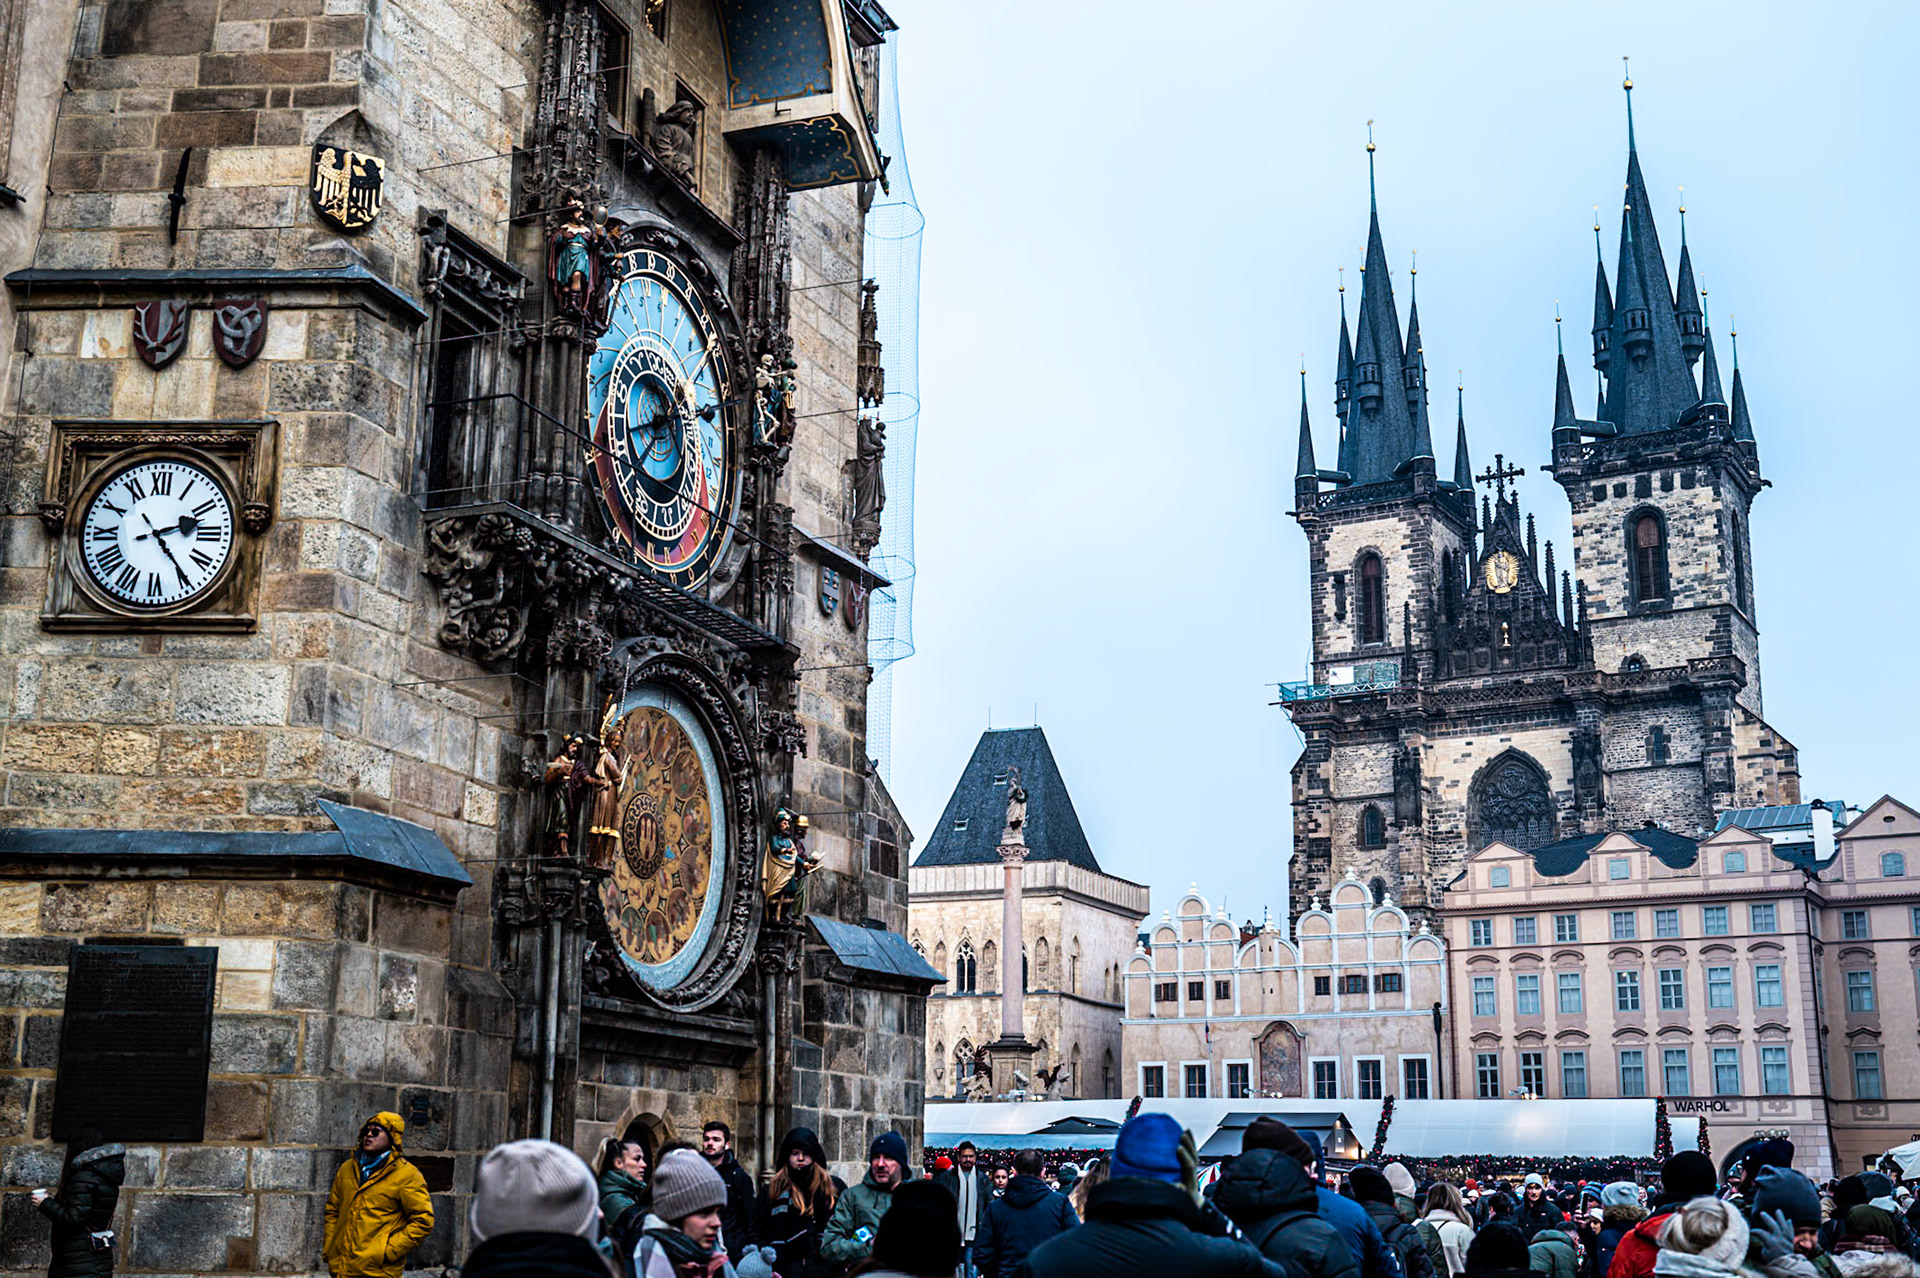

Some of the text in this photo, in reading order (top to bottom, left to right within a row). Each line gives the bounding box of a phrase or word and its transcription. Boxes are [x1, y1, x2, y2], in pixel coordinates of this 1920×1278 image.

[124, 477, 147, 504] XI
[150, 472, 173, 496] XII
[102, 499, 128, 518] X
[191, 498, 217, 517] II
[196, 526, 221, 542] III
[95, 544, 126, 577] VIII
[115, 564, 141, 594] VII
[147, 572, 163, 597] VI
[1674, 1100, 1730, 1112] WARHOL
